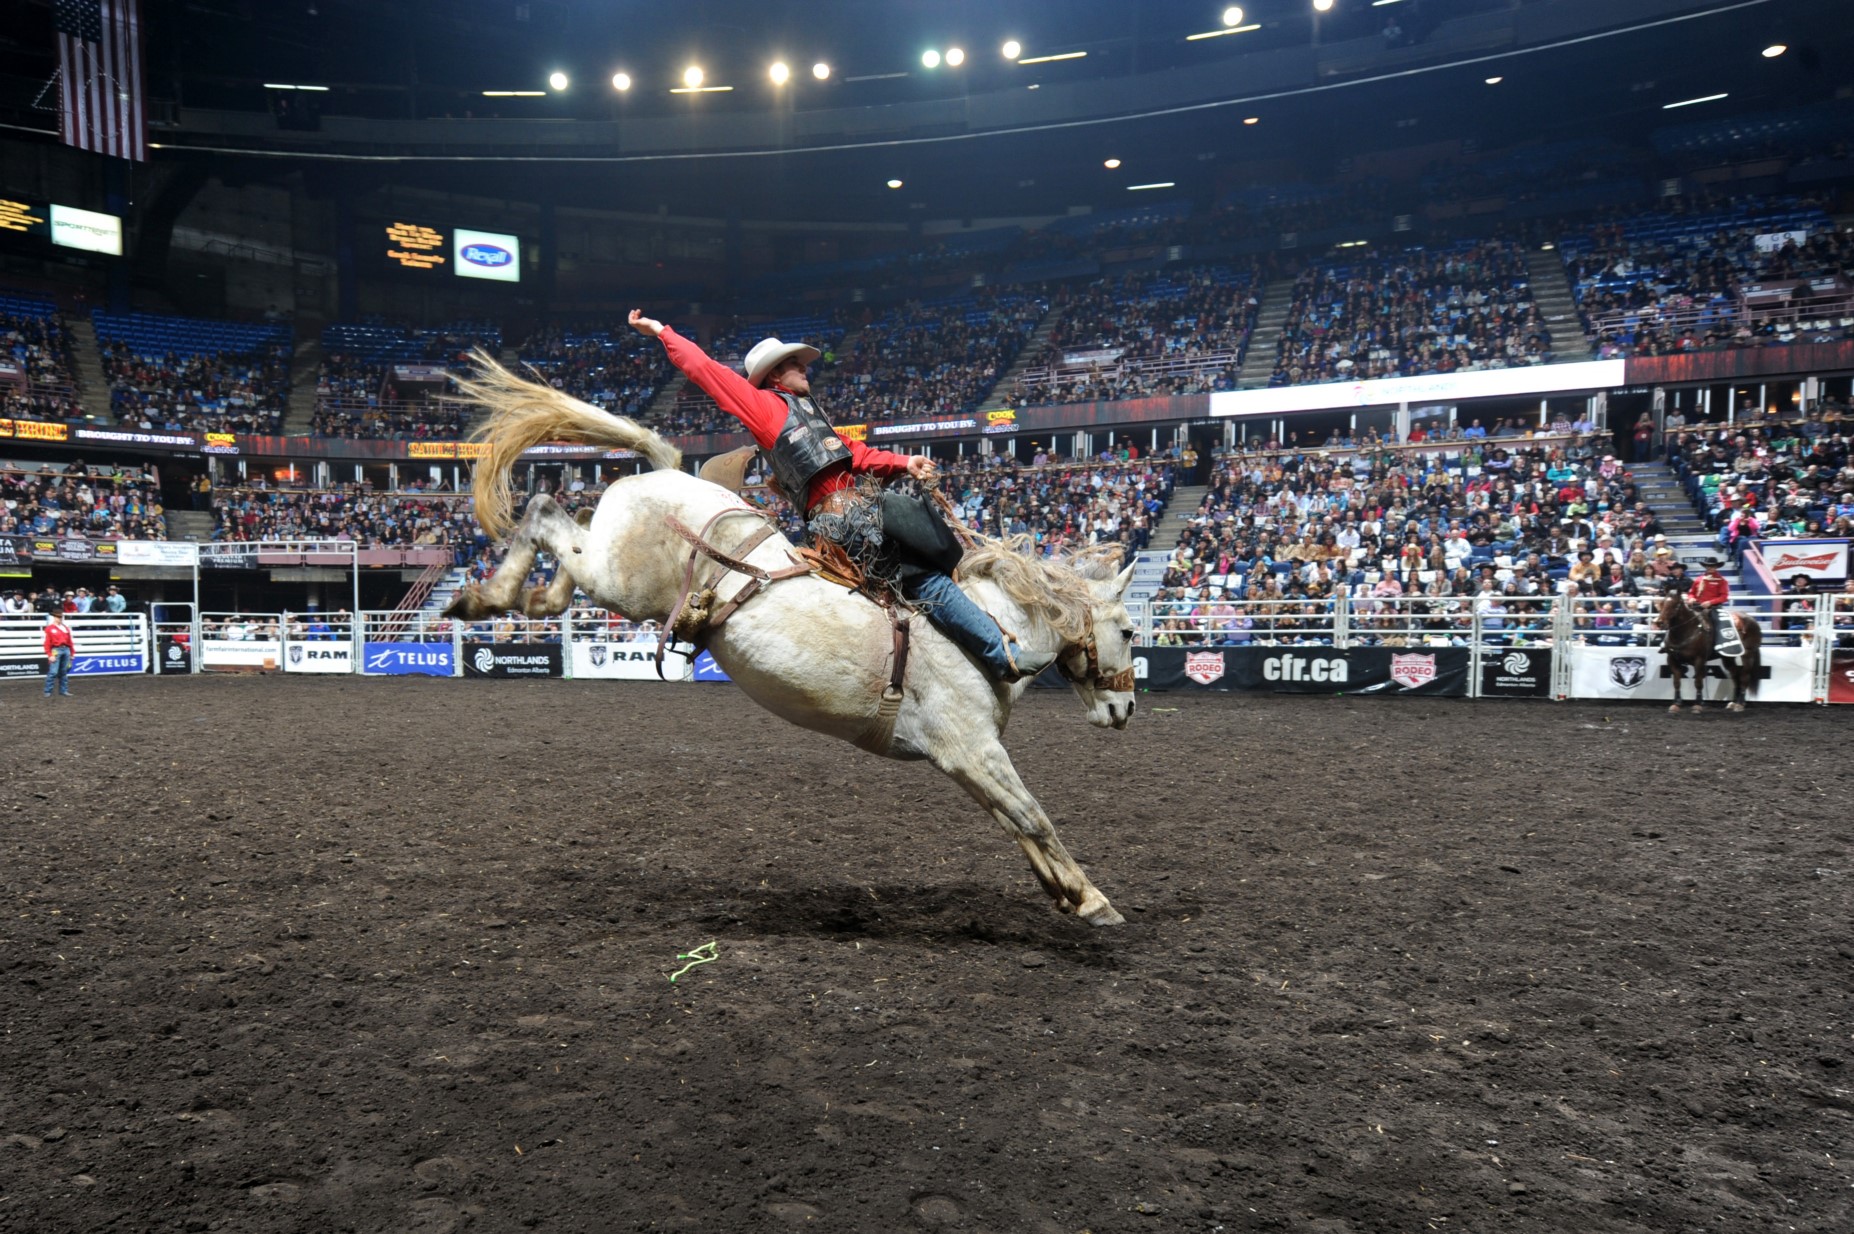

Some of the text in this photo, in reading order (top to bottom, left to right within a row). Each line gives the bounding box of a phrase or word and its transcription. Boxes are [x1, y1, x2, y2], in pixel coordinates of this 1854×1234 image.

[466, 247, 507, 265] Rexall
[987, 410, 1016, 421] COOK
[874, 423, 922, 435] BROUGHT
[922, 422, 936, 431] TO
[938, 420, 959, 430] YOU
[75, 429, 132, 441] BROUGHT
[133, 433, 150, 442] TO
[151, 434, 175, 444] YOU
[204, 433, 236, 443] COOK
[1770, 556, 1838, 567] Budweiser
[307, 651, 348, 659] RAM
[397, 652, 449, 666] TELUS
[495, 656, 550, 665] NORTHLANDS
[98, 658, 138, 668] TELUS
[1189, 664, 1221, 672] RODEO
[1263, 653, 1348, 682] cfr.ca
[1395, 666, 1431, 675] RODEO
